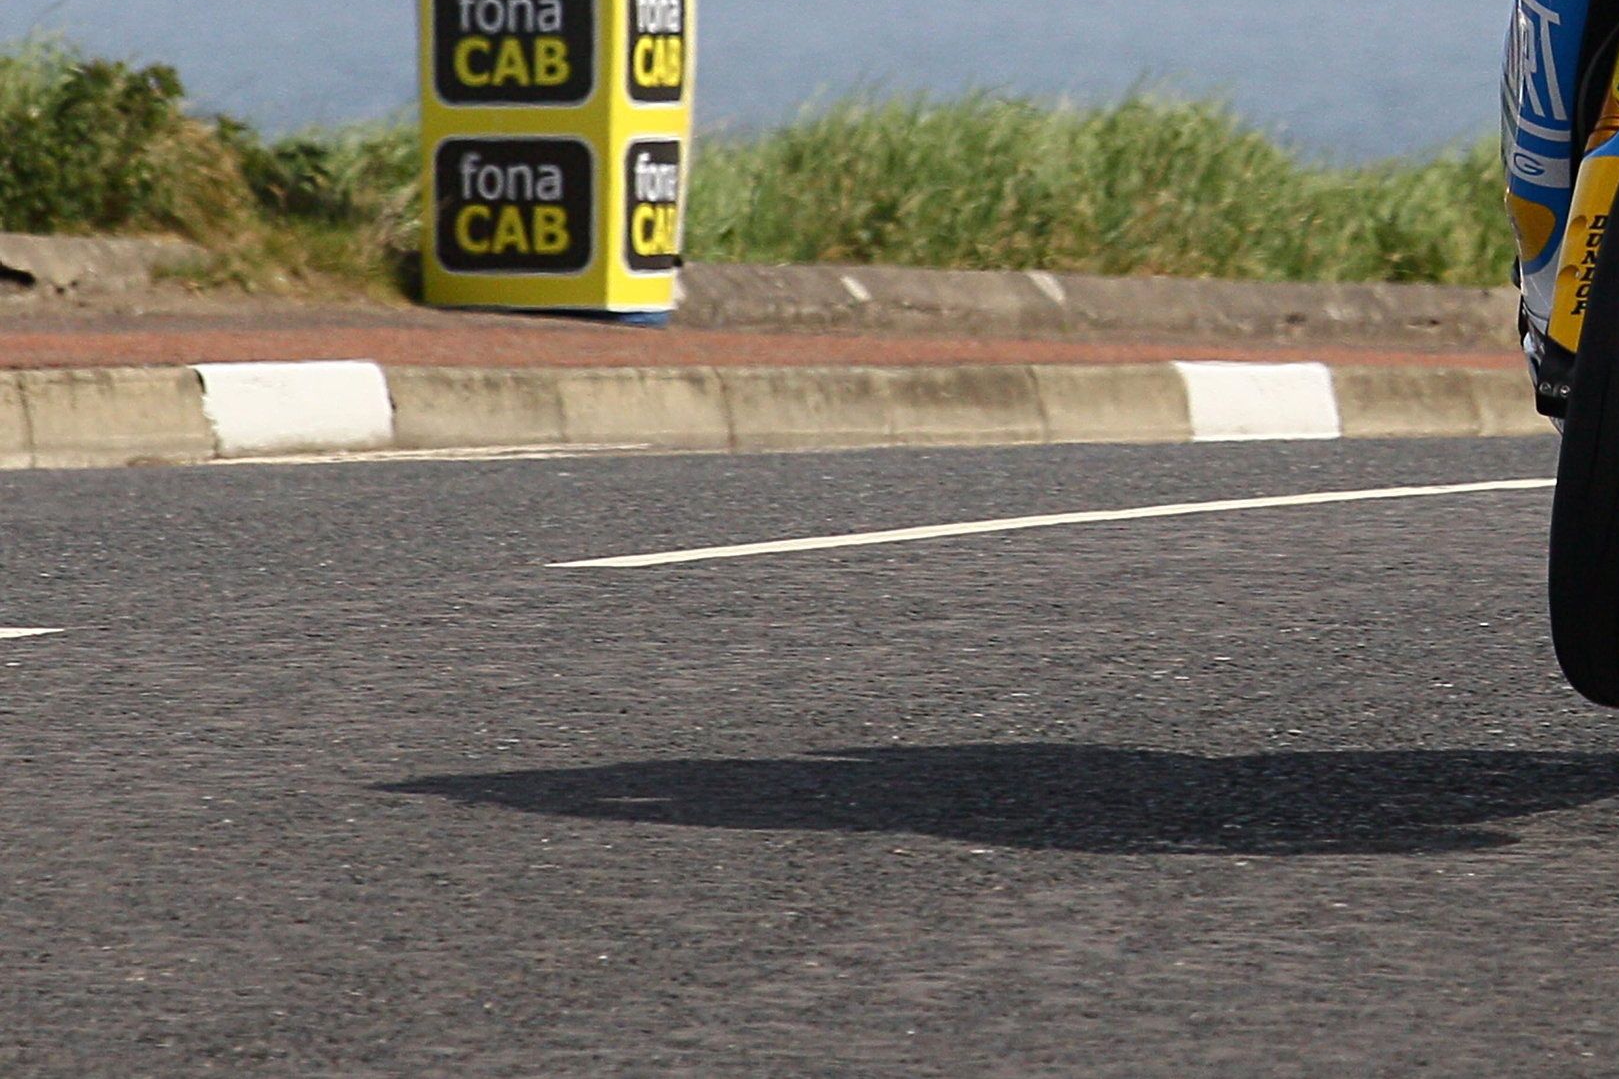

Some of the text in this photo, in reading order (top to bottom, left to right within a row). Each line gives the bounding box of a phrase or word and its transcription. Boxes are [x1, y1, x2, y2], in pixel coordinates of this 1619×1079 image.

[453, 36, 572, 88] CAB
[633, 34, 683, 88] CAB
[459, 152, 563, 202] fona
[454, 203, 570, 256] CAB
